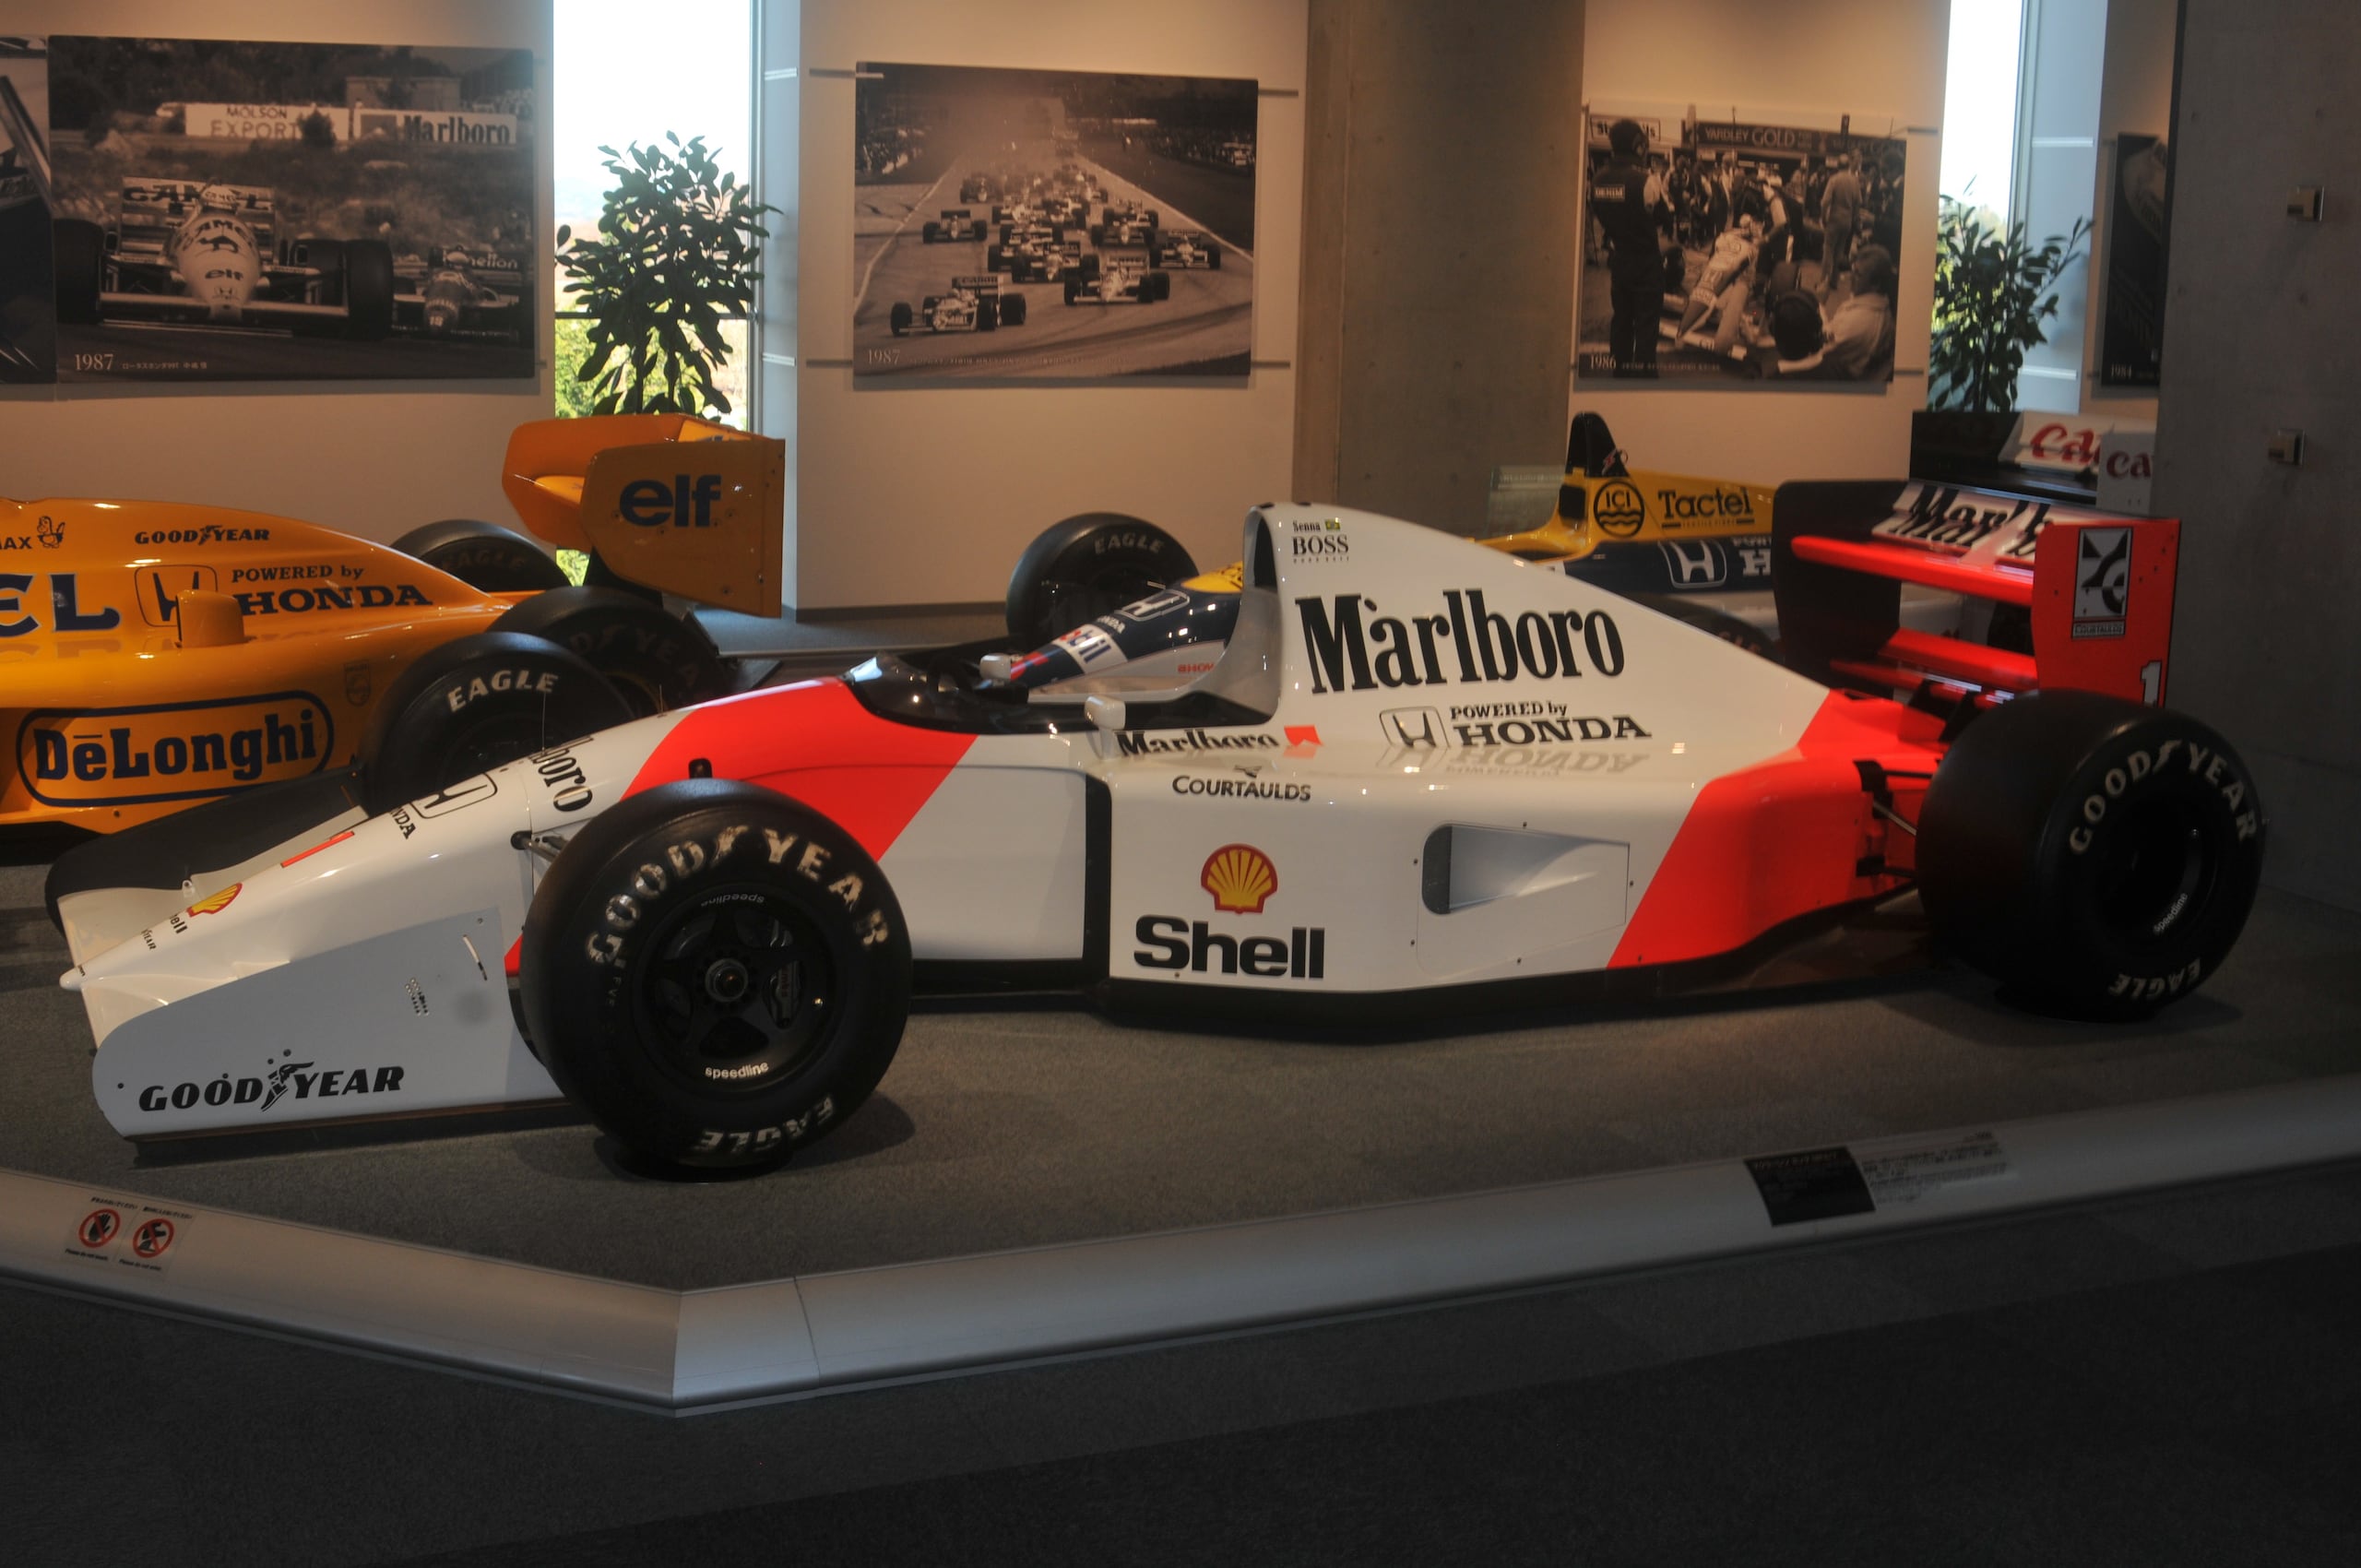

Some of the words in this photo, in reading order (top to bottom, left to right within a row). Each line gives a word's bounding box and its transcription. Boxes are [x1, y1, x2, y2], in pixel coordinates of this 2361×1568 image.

[226, 106, 288, 120] MOLSON
[403, 115, 511, 145] Marlboro
[1752, 128, 1796, 148] GOLD
[75, 353, 113, 371] 1987
[868, 350, 900, 365] 1987
[1590, 354, 1617, 370] 1986
[619, 474, 721, 528] elf
[1605, 490, 1631, 508] ICI
[1657, 487, 1754, 519] Tactel
[1292, 519, 1321, 532] Senna
[1095, 531, 1166, 554] EAGLE
[1292, 534, 1349, 555] BOSS
[232, 566, 333, 583] POWERED
[340, 564, 365, 581] by
[239, 584, 433, 616] HONDA
[1295, 588, 1624, 695] Marlboro
[447, 670, 559, 713] EAGLE
[2140, 659, 2162, 708] 1
[1450, 702, 1544, 720] POWERED
[1548, 700, 1568, 716] by
[1115, 726, 1279, 757] Marlboro
[1453, 714, 1652, 746] HONDA
[1172, 775, 1311, 802] COURTAULDS
[701, 894, 765, 908] speedline
[2153, 892, 2189, 935] speedline
[1133, 914, 1325, 980] Shell
[2107, 957, 2201, 1000] EAGLE
[705, 1061, 769, 1079] speedline
[692, 1097, 835, 1155] EAGLE
